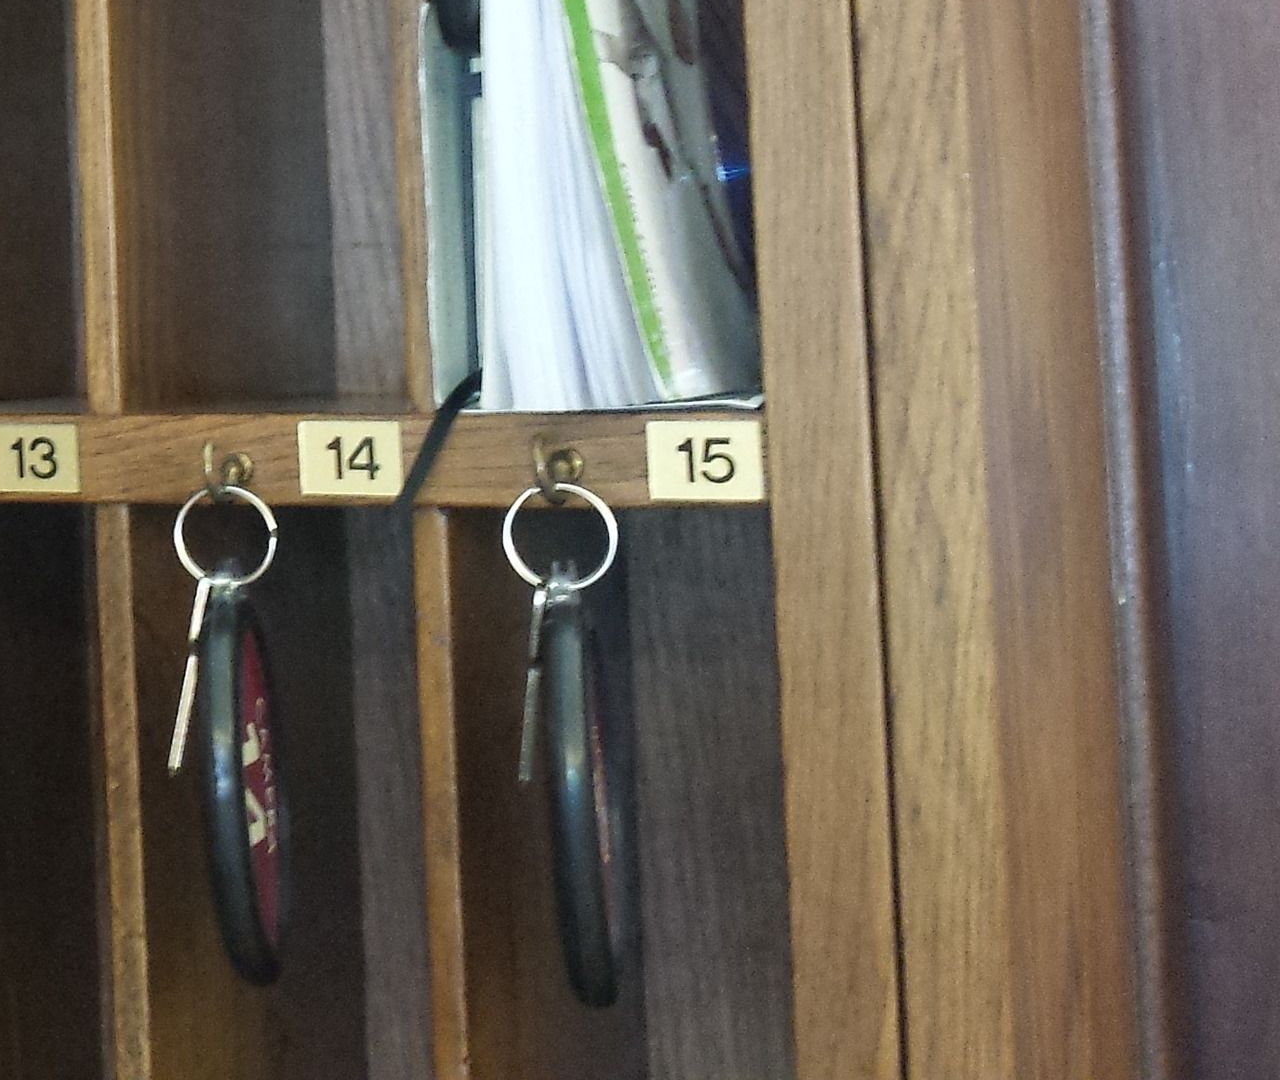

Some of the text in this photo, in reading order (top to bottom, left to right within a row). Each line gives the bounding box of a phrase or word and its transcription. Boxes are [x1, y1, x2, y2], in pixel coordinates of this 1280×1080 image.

[10, 437, 58, 480] 13
[326, 435, 381, 481] 14
[676, 436, 736, 483] 15
